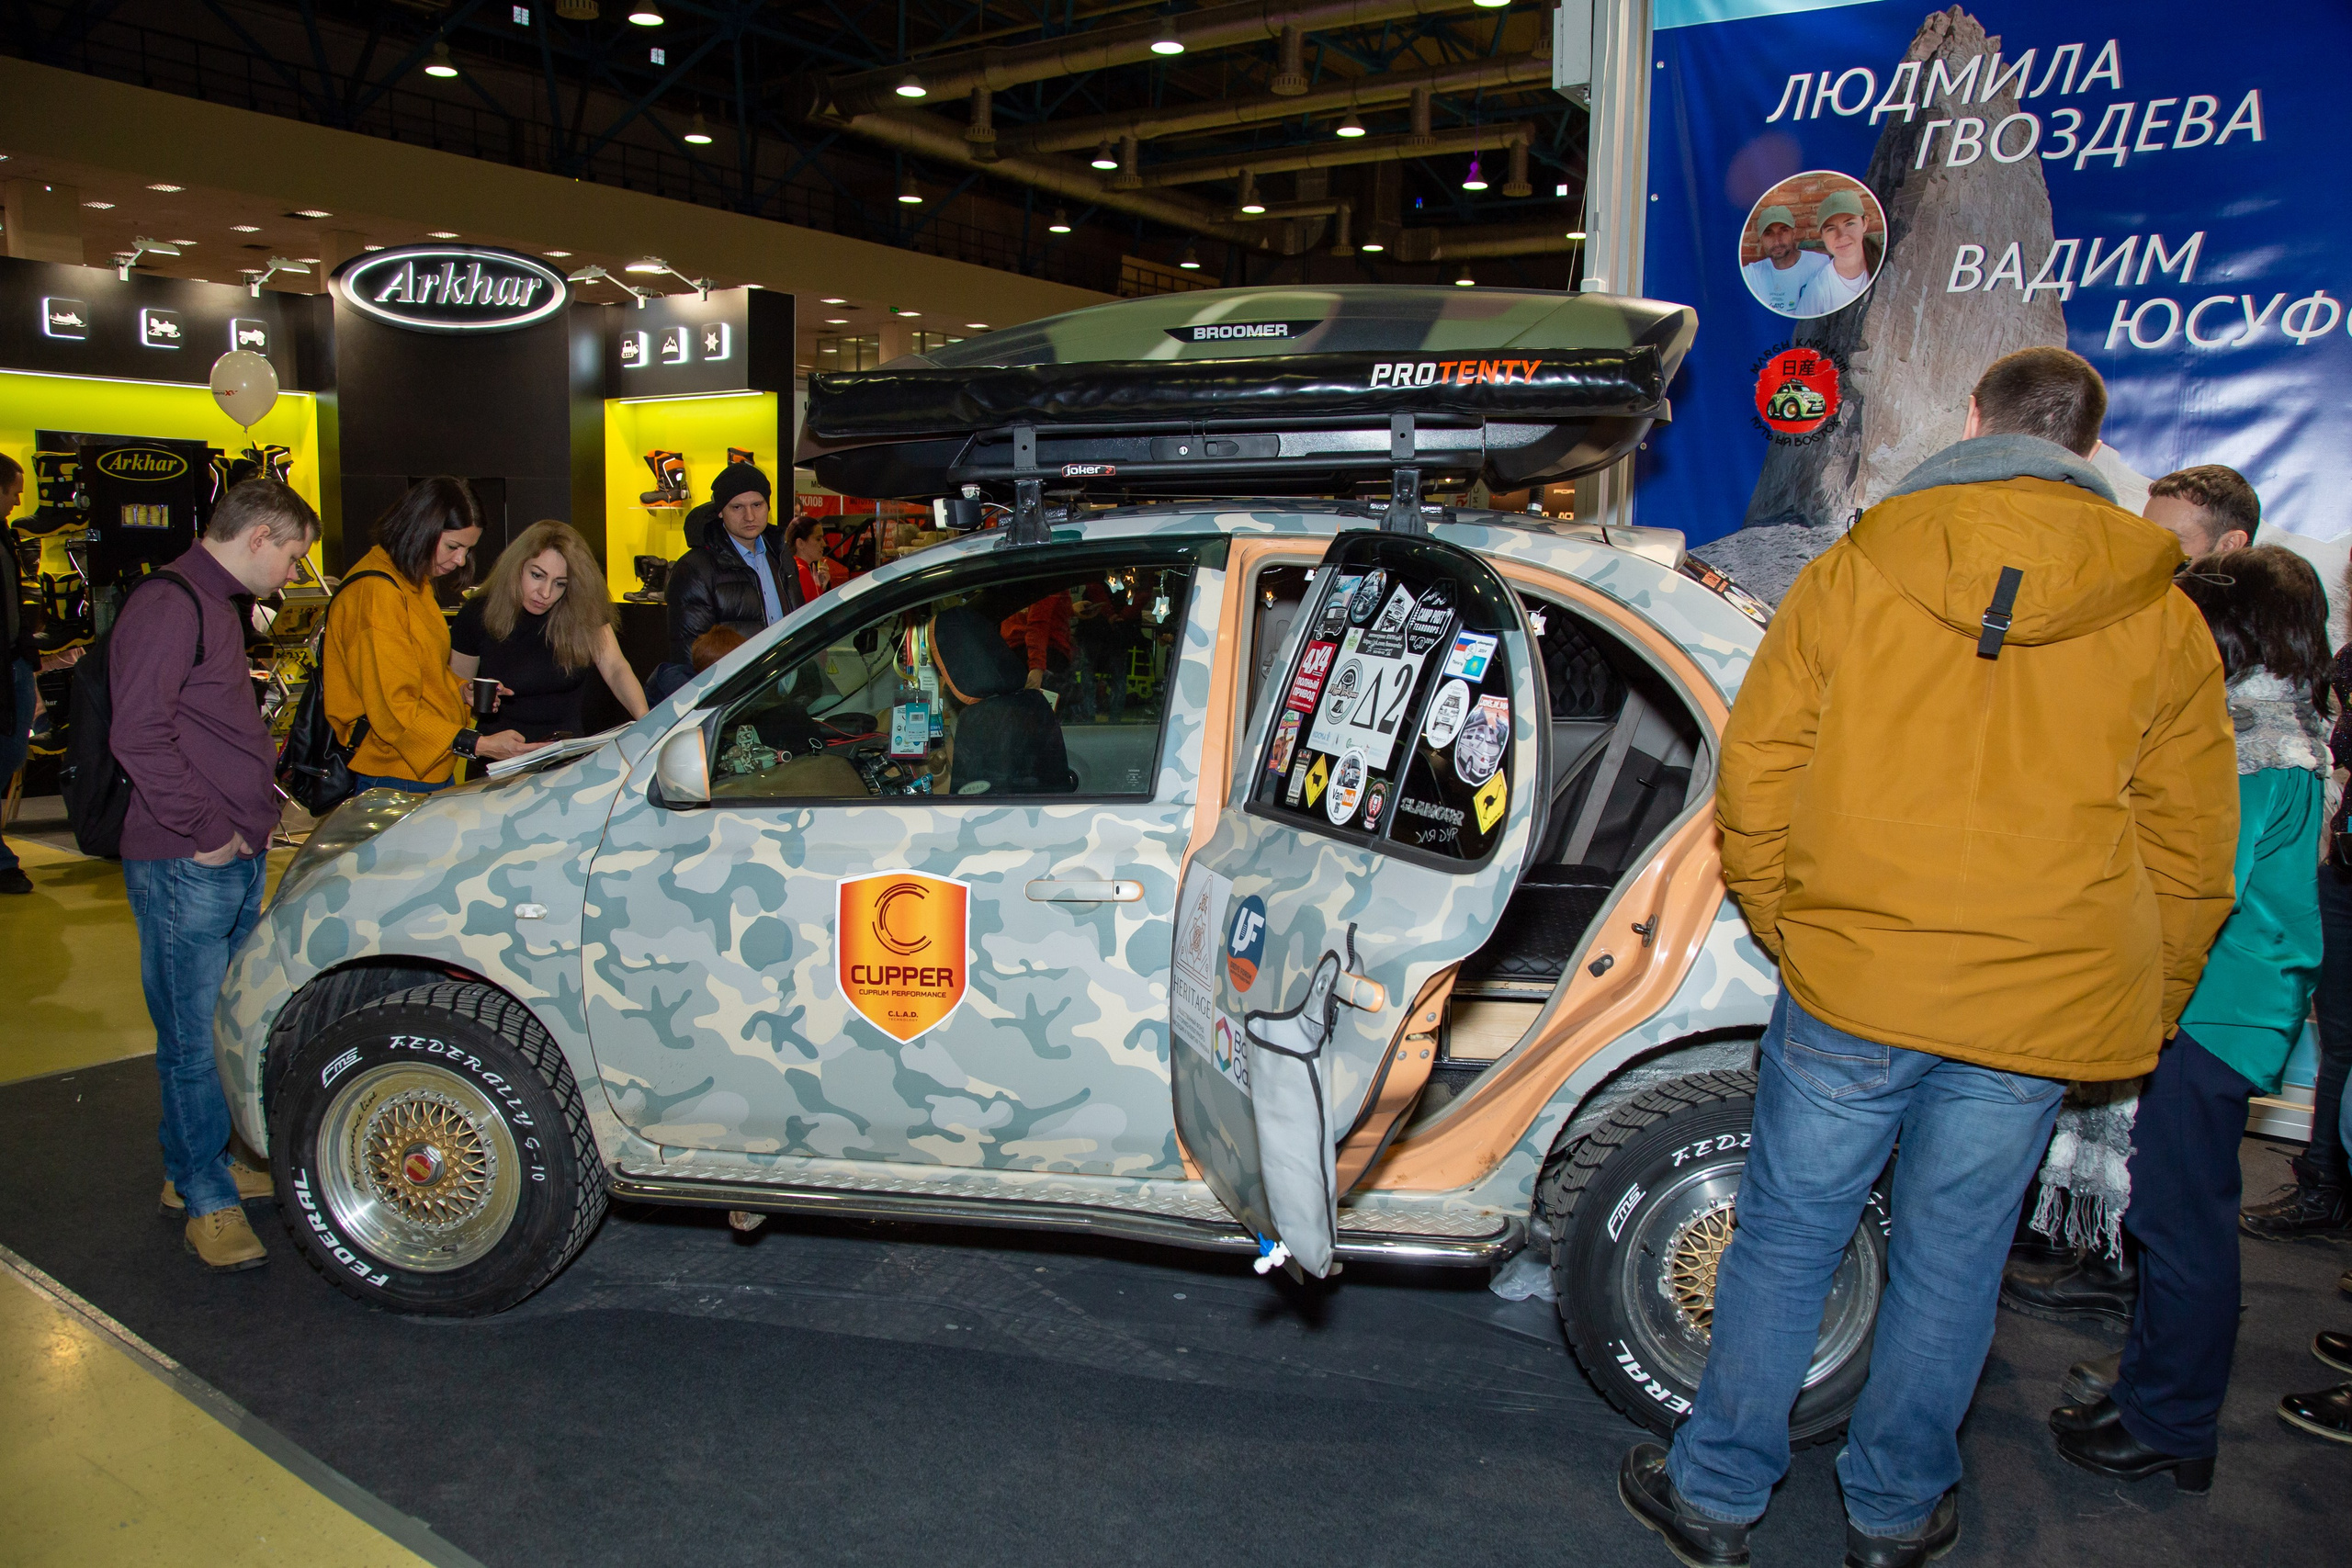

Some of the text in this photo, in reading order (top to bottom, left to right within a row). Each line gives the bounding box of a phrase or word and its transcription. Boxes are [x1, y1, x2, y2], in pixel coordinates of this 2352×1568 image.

[1766, 39, 2124, 125] ЛЮДМИЛА
[1915, 89, 2266, 171] ГВОЗДЕВА
[1946, 231, 2207, 302] ВАДИМ
[374, 261, 542, 306] Arkhar
[1193, 323, 1288, 340] BROOMER
[2103, 289, 2352, 350] ЮСУФ
[1370, 359, 1543, 387] PROTENTY
[1782, 359, 1815, 376] 日産
[1794, 417, 1842, 447] ВОСТОК
[107, 454, 177, 472] Arkhar
[1066, 465, 1101, 477] joker
[1416, 607, 1447, 625] CAMP POST
[1414, 624, 1440, 635] TEARDROPS
[1292, 687, 1316, 703] ПРИВОД
[1296, 676, 1320, 690] ПОЛНЫЙ
[851, 964, 954, 987] CUPPER
[892, 990, 946, 998] PERFORMANCE
[1172, 974, 1212, 1020] HERITAGE
[293, 1167, 390, 1288] FEDERAL
[1615, 1338, 1693, 1415] ERAL
